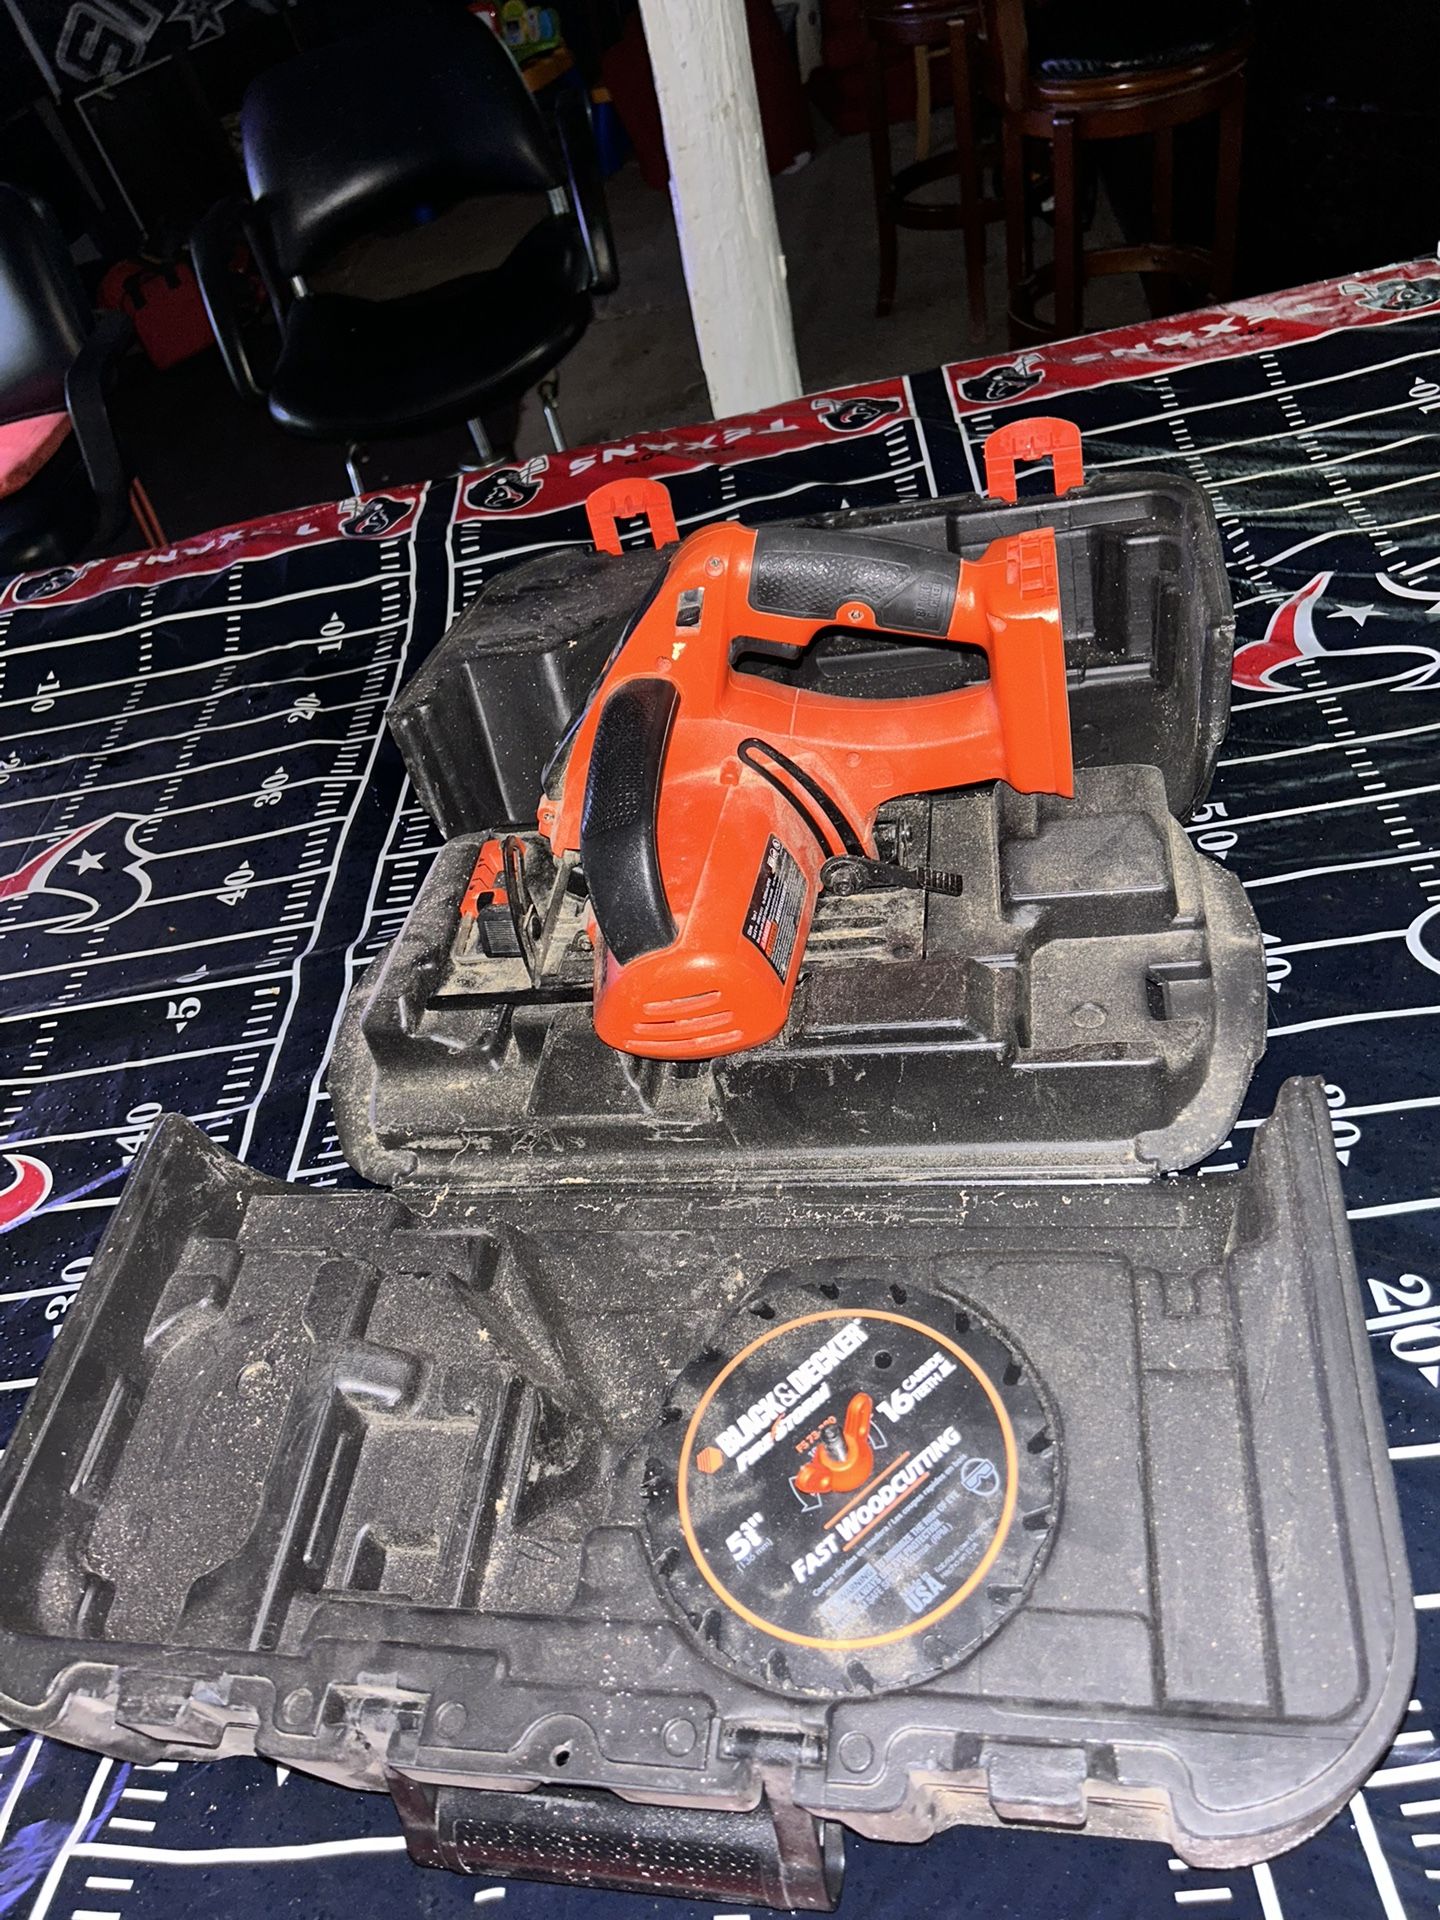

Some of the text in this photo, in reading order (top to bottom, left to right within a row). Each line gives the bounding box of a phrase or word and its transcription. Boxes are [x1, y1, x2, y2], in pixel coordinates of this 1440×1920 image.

[569, 418, 800, 477] TEXANS
[317, 620, 345, 654] 10
[31, 680, 60, 712] 10
[287, 697, 321, 723] 20
[254, 773, 289, 808] 30
[216, 869, 255, 906] 40
[1367, 1274, 1440, 1363] 20
[715, 1322, 869, 1458] BLACK&DECKER
[875, 1351, 945, 1423] 16 CARBIDE
[911, 1371, 944, 1401] TEETH
[790, 1426, 963, 1584] FAST WOODCUTTING
[812, 1577, 834, 1597] Cortes
[856, 1547, 866, 1557] en
[864, 1525, 890, 1550] madera
[890, 1512, 903, 1525] Les
[902, 1494, 924, 1515] coupes
[945, 1465, 955, 1475] en
[840, 1567, 874, 1600] WARNING
[910, 1521, 925, 1536] THE
[922, 1508, 940, 1526] RISK
[936, 1500, 947, 1513] OF
